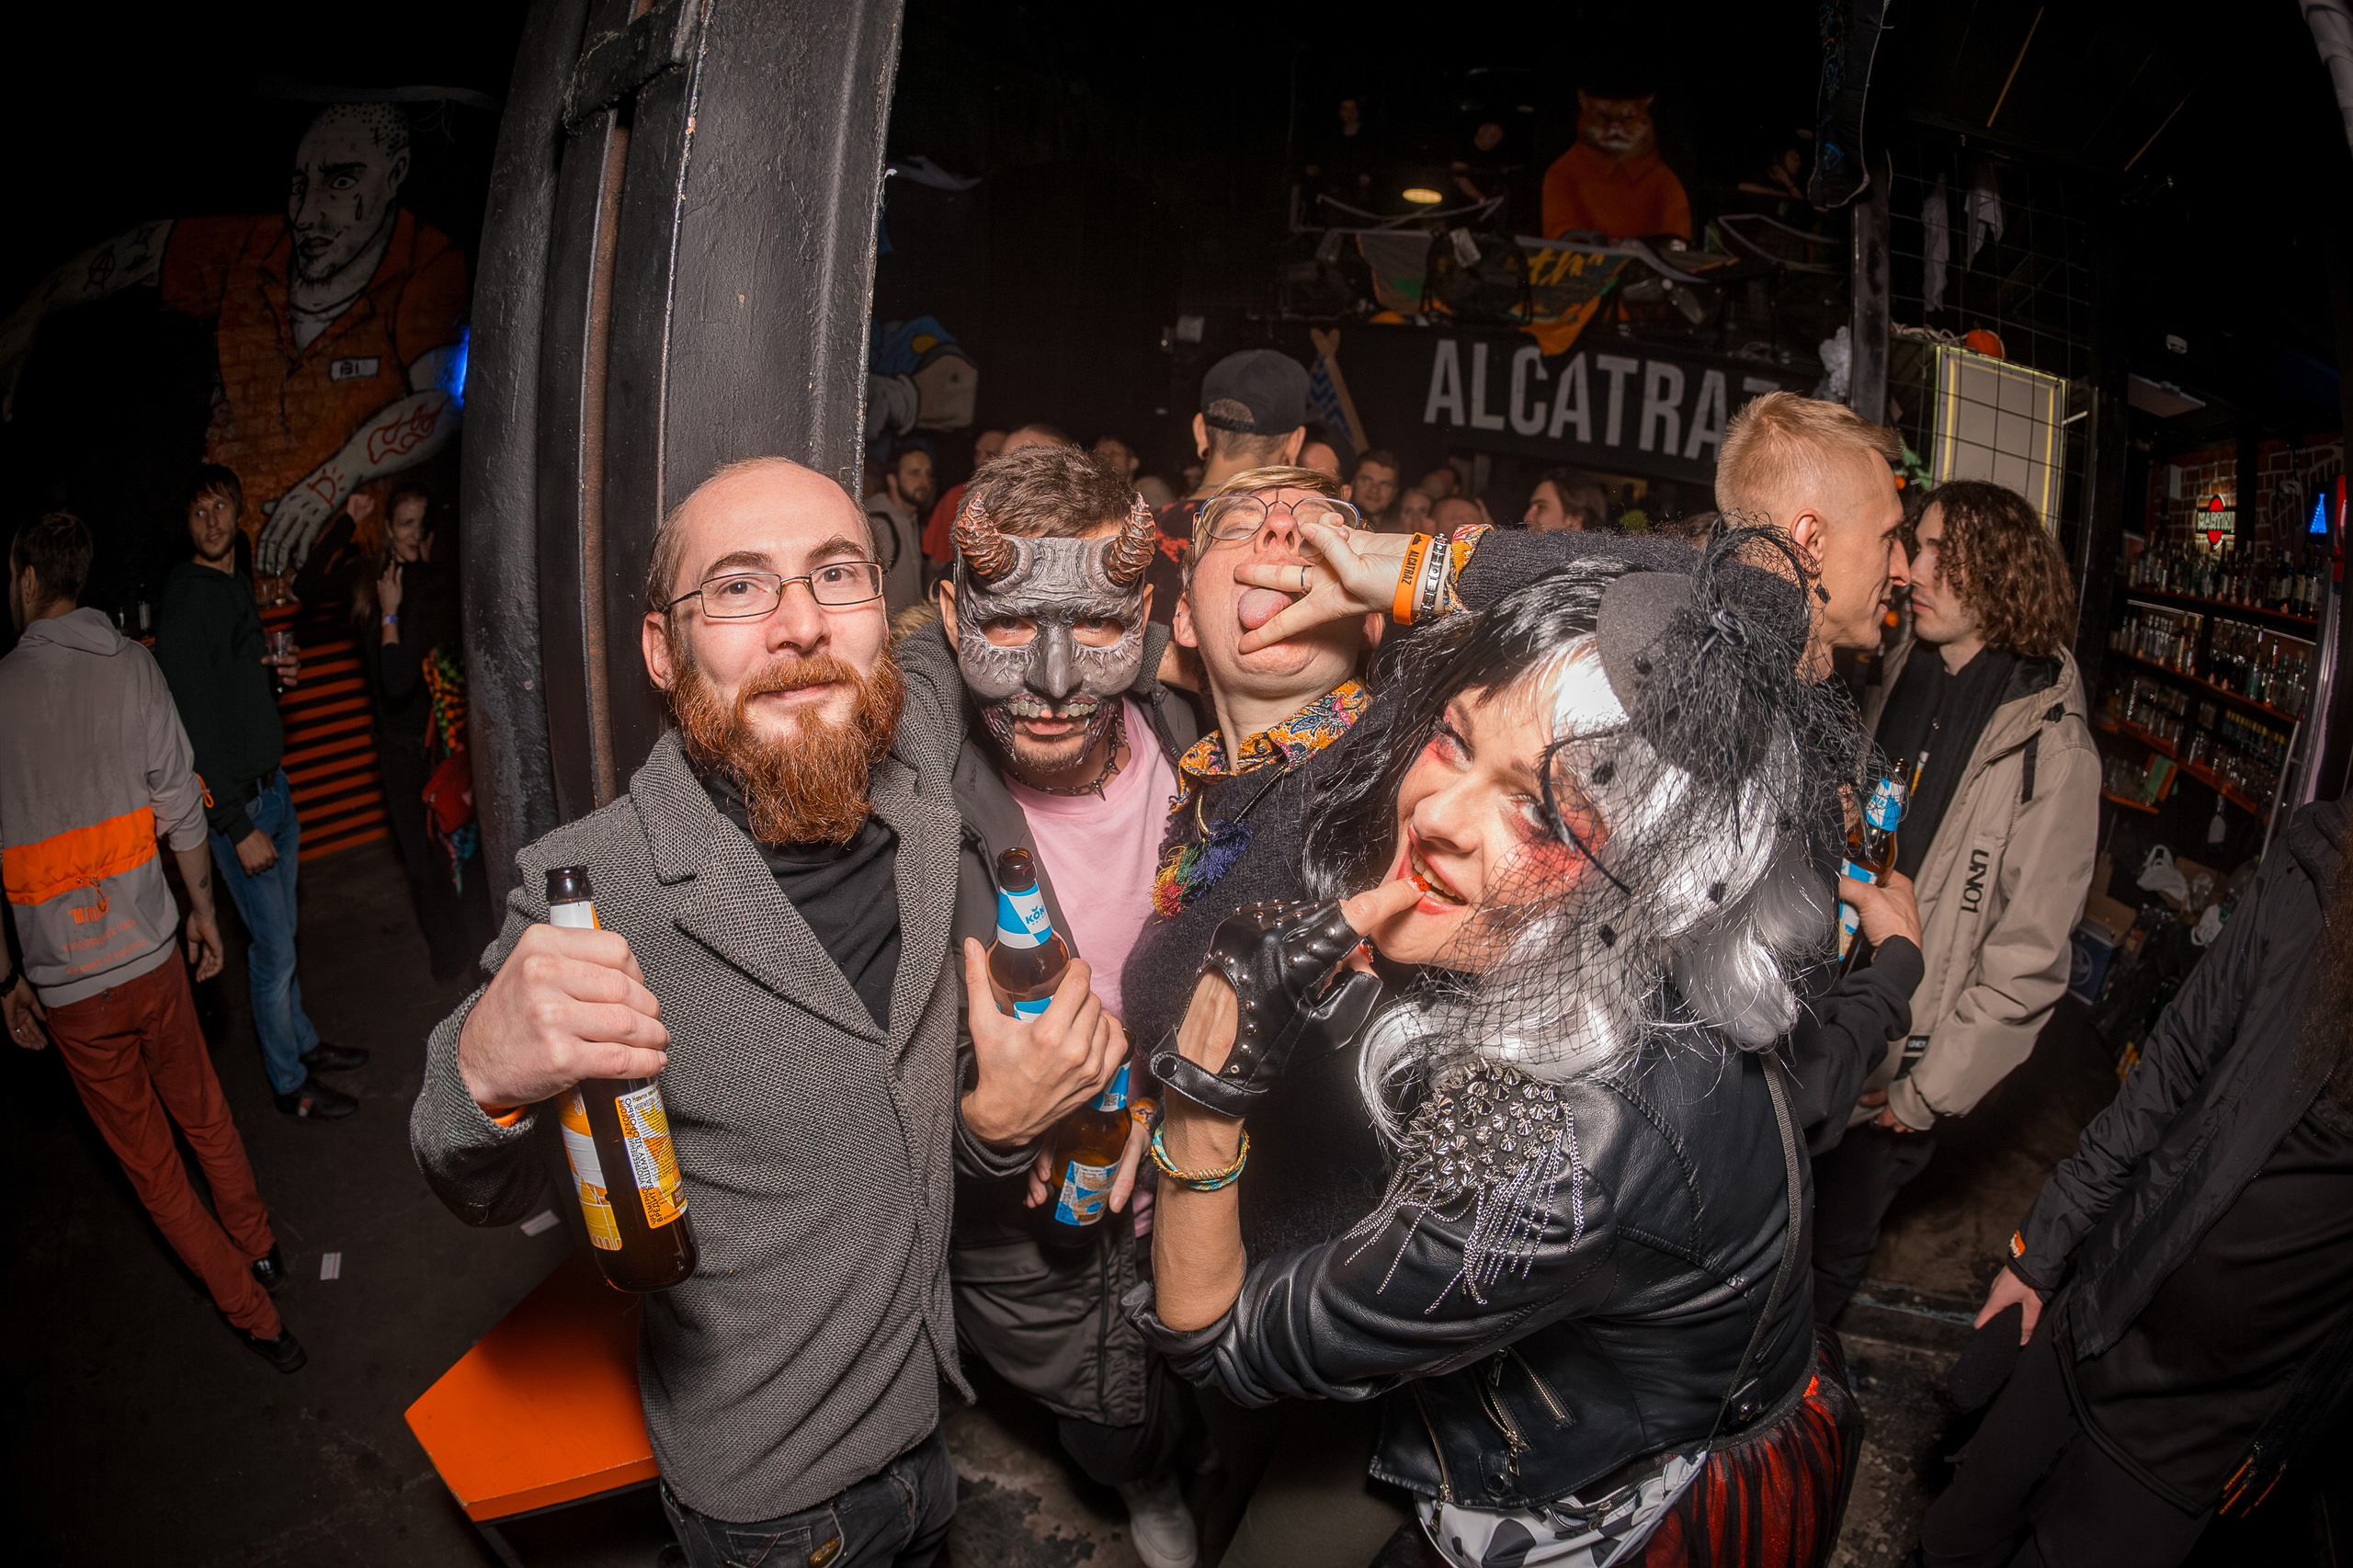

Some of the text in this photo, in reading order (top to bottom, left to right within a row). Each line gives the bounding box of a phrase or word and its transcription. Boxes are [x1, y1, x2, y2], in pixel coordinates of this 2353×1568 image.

[1424, 338, 1780, 460] ALCATRA
[1401, 550, 1420, 585] ALCATRAZ
[625, 1097, 642, 1150] ЗДОРОВЬЮ
[619, 1098, 656, 1225] ЧРЕЗМЕРНОЕ УПОТРЕБЛЕНИЕ АЛКОГОЛЯ
[639, 1152, 654, 1189] ВАШЕМУ
[649, 1191, 664, 1222] ВРЕДИТ
